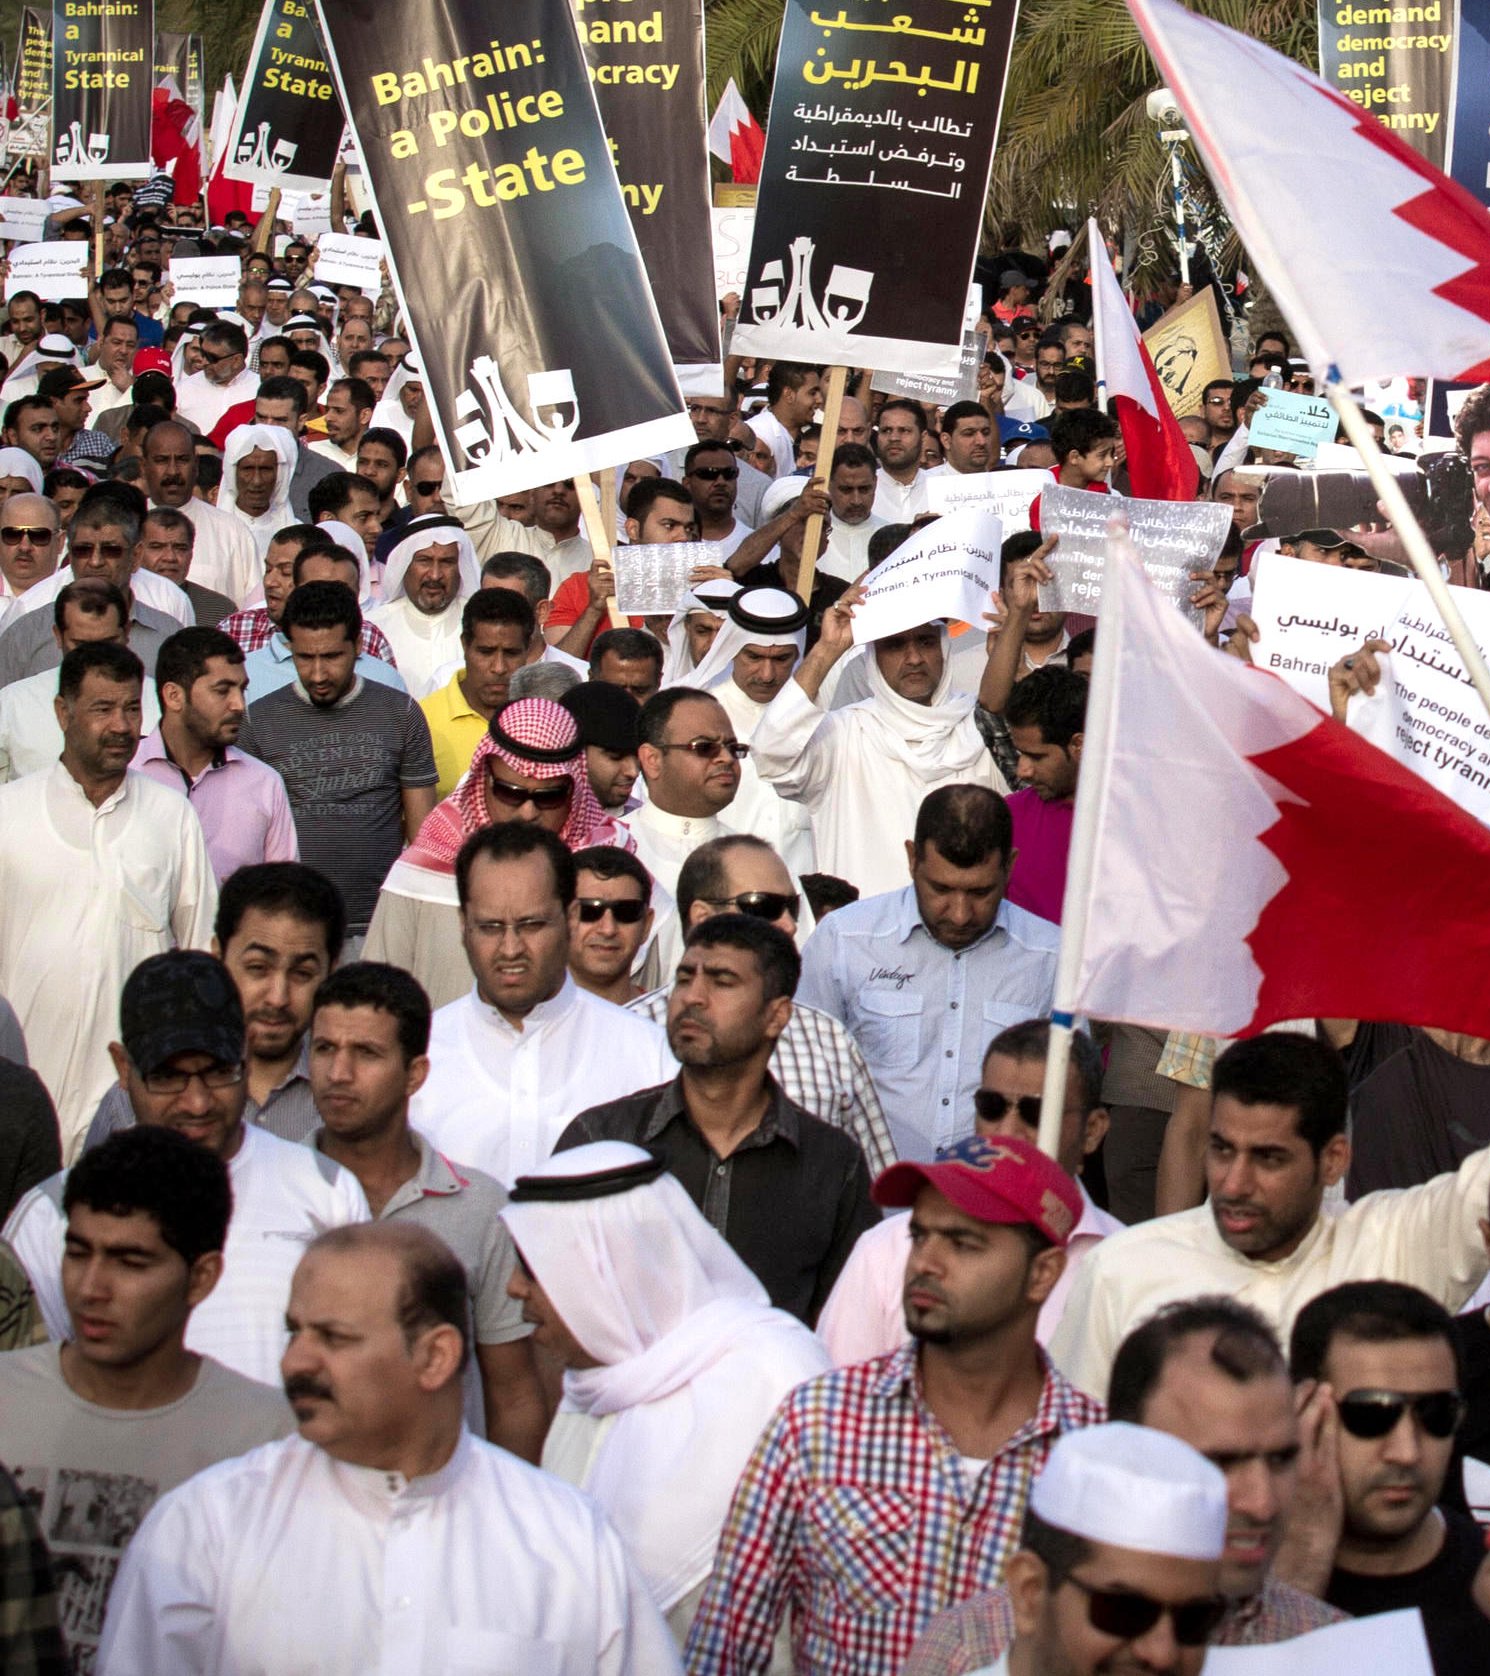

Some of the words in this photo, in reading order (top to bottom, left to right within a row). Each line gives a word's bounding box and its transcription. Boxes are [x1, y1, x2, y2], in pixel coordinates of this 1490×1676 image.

[65, 3, 138, 16] Bahrain:
[1336, 2, 1440, 25] demand
[65, 24, 80, 40] a
[276, 22, 293, 39] a
[574, 12, 664, 44] and
[810, 8, 986, 46] شعب
[25, 48, 52, 58] dema
[26, 38, 52, 48] peop
[1336, 34, 1452, 52] democracy
[65, 48, 144, 65] Tyrannical
[271, 48, 329, 72] Tyrann
[1338, 56, 1385, 78] and
[65, 70, 130, 89] State
[154, 65, 180, 74] rain:
[372, 40, 545, 106] Bahrain:
[587, 64, 680, 90] cracy
[803, 48, 980, 96] البحرين
[18, 90, 50, 100] tyrann
[262, 68, 332, 100] State
[390, 130, 419, 160] a
[428, 90, 564, 148] Police
[793, 103, 903, 130] بالديمقراطية
[907, 116, 974, 138] تطالب
[1374, 112, 1439, 133] anny
[791, 136, 875, 156] استبداد
[878, 145, 966, 172] وترفض
[407, 146, 586, 220] -State
[785, 166, 962, 200] السلطة
[896, 377, 922, 390] reject
[924, 383, 958, 398] tyranny
[928, 544, 957, 560] نظام
[912, 576, 920, 584] A
[922, 568, 974, 582] Tyrannical
[1071, 582, 1101, 599] reje
[1277, 615, 1359, 640] بوليسي
[1364, 626, 1385, 641] ام
[1270, 653, 1328, 676] Bahrai
[1391, 634, 1477, 689] ستبداد
[1394, 682, 1417, 702] The
[1418, 697, 1472, 728] people
